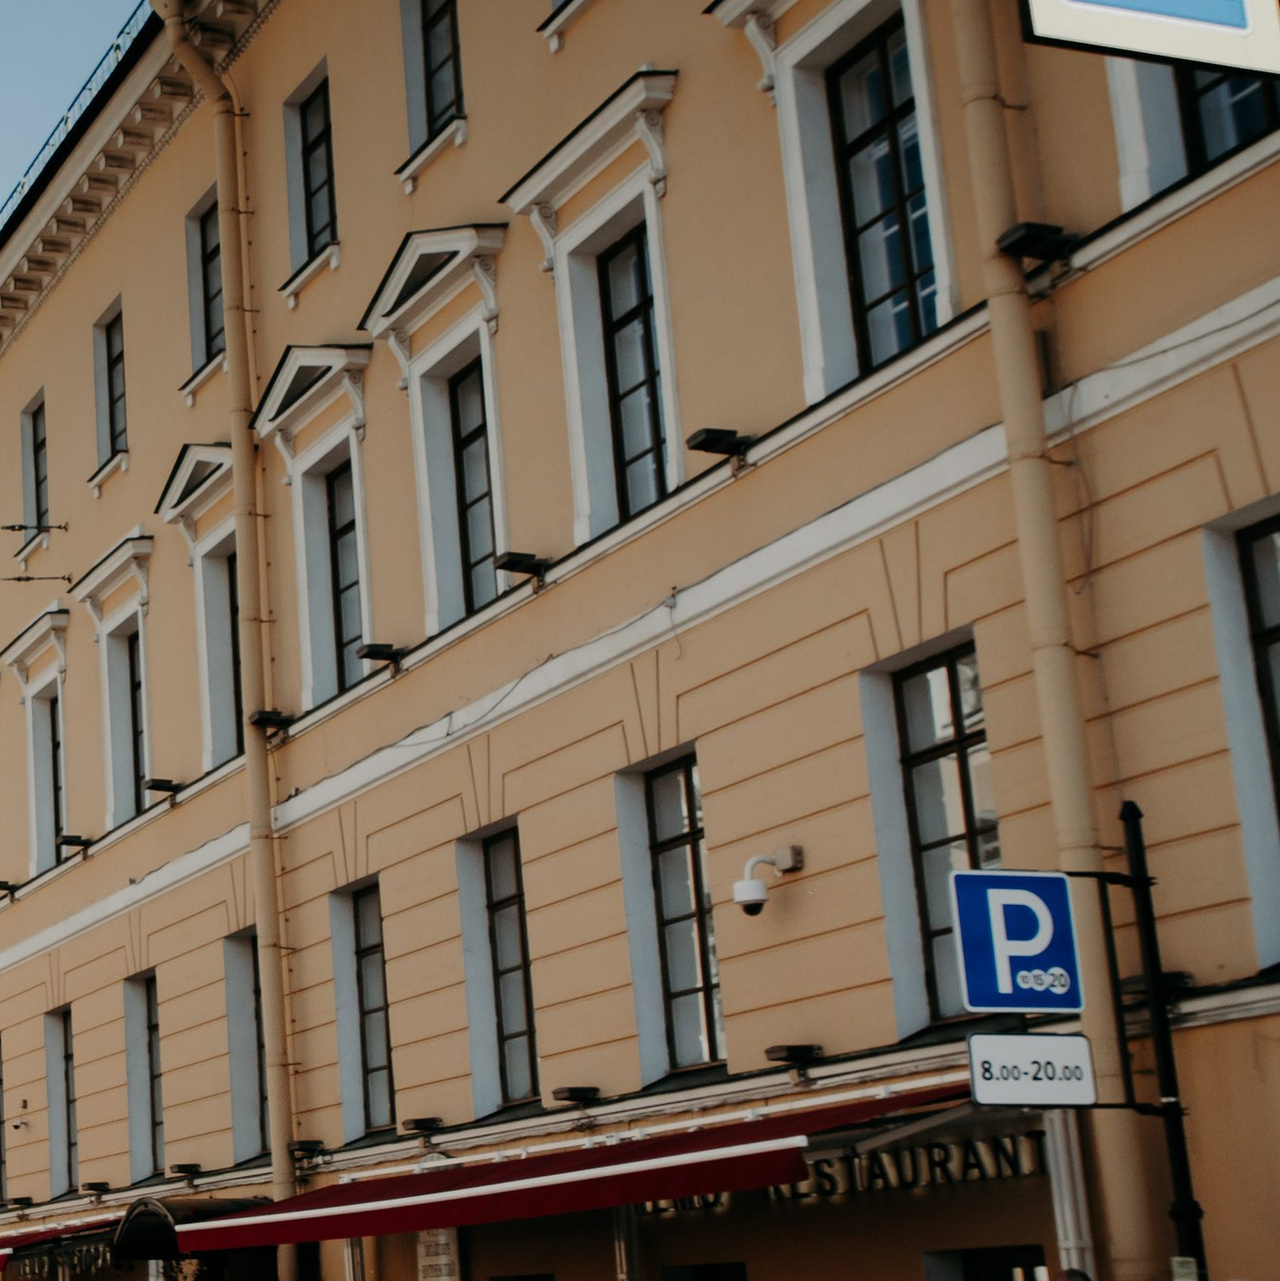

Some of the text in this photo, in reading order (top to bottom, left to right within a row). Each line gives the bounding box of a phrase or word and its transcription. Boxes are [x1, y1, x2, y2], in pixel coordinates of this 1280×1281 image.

[987, 888, 1054, 994] P
[1049, 972, 1068, 988] 20
[981, 1060, 1083, 1081] 8.00-20.00
